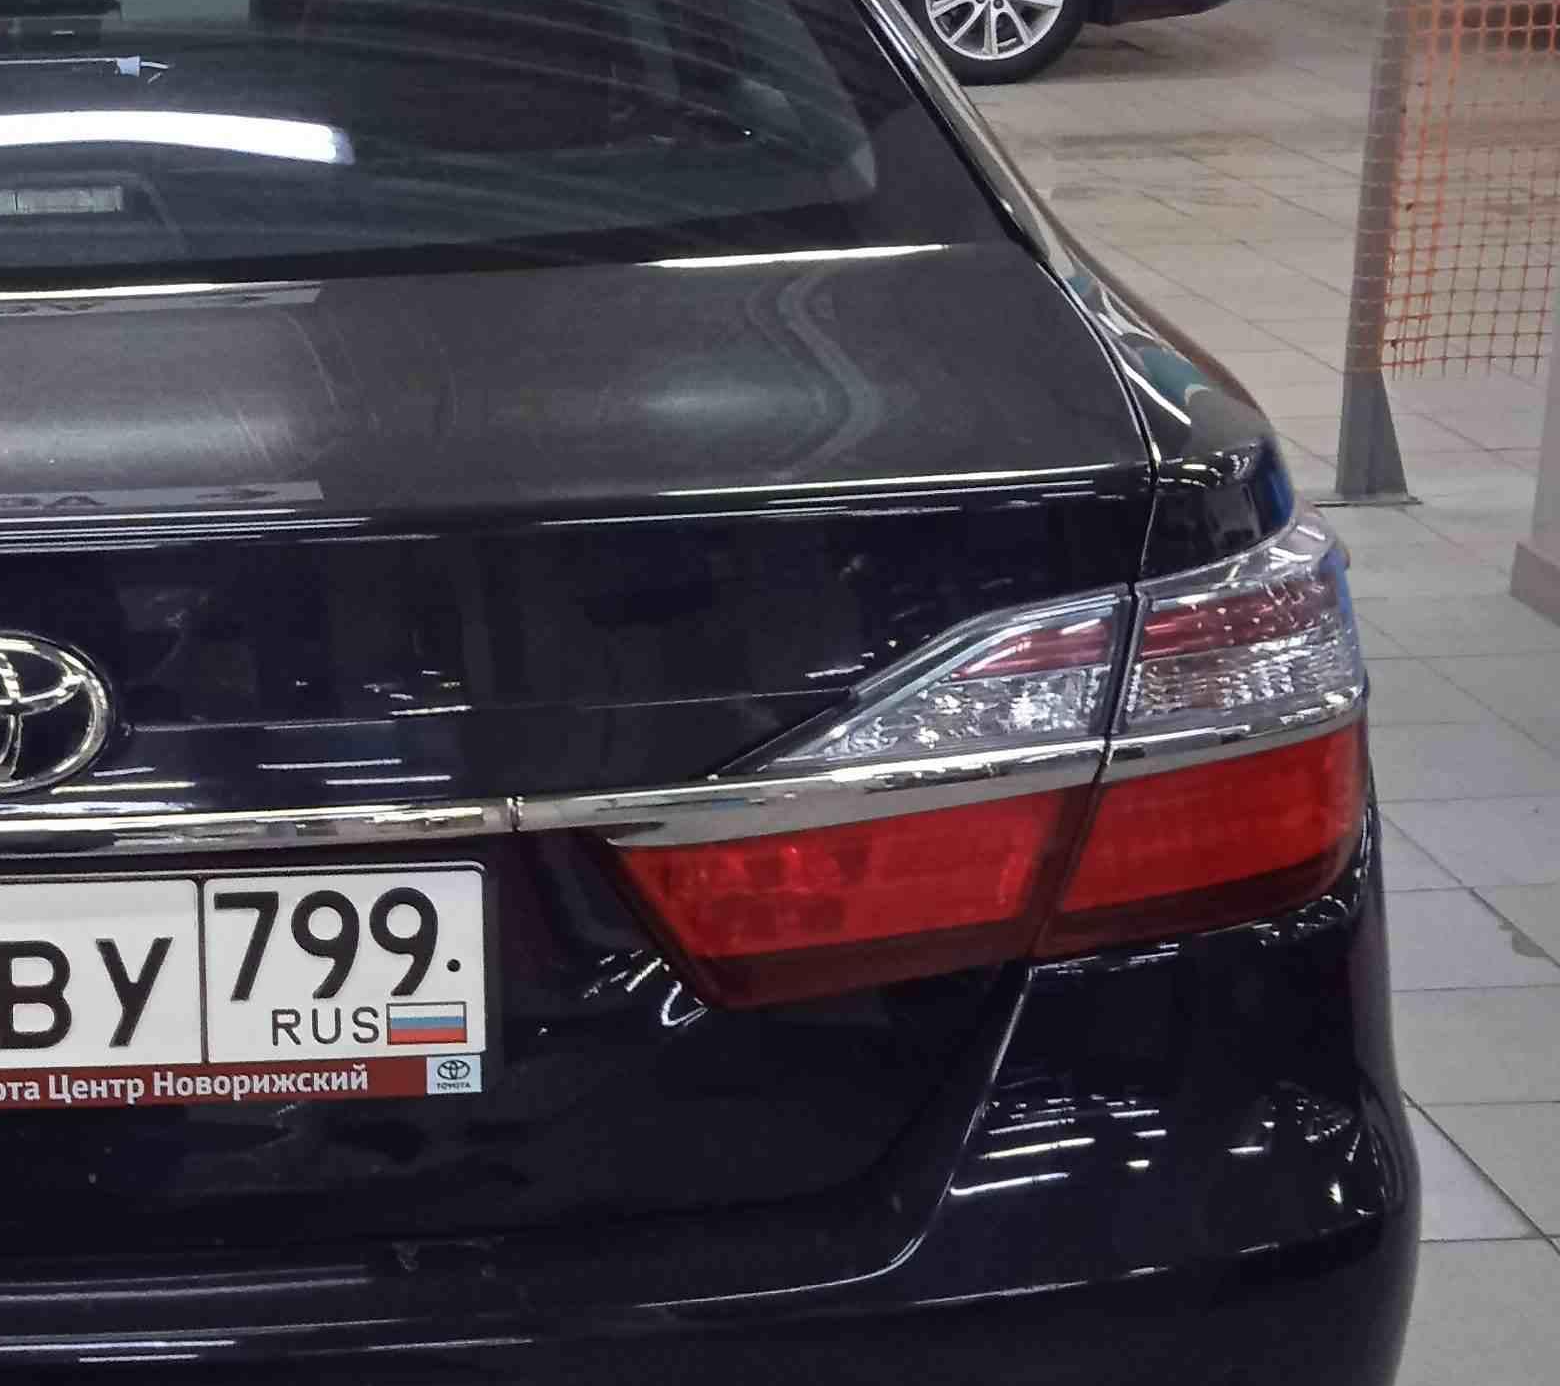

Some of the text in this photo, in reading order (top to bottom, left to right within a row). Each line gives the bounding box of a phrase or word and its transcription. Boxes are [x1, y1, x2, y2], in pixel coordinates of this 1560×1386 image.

[213, 886, 439, 1002] 799
[271, 1006, 380, 1047] RUS
[48, 1074, 145, 1104] Центр
[153, 1063, 369, 1101] Новорижский
[436, 1081, 472, 1091] TOYOTA
